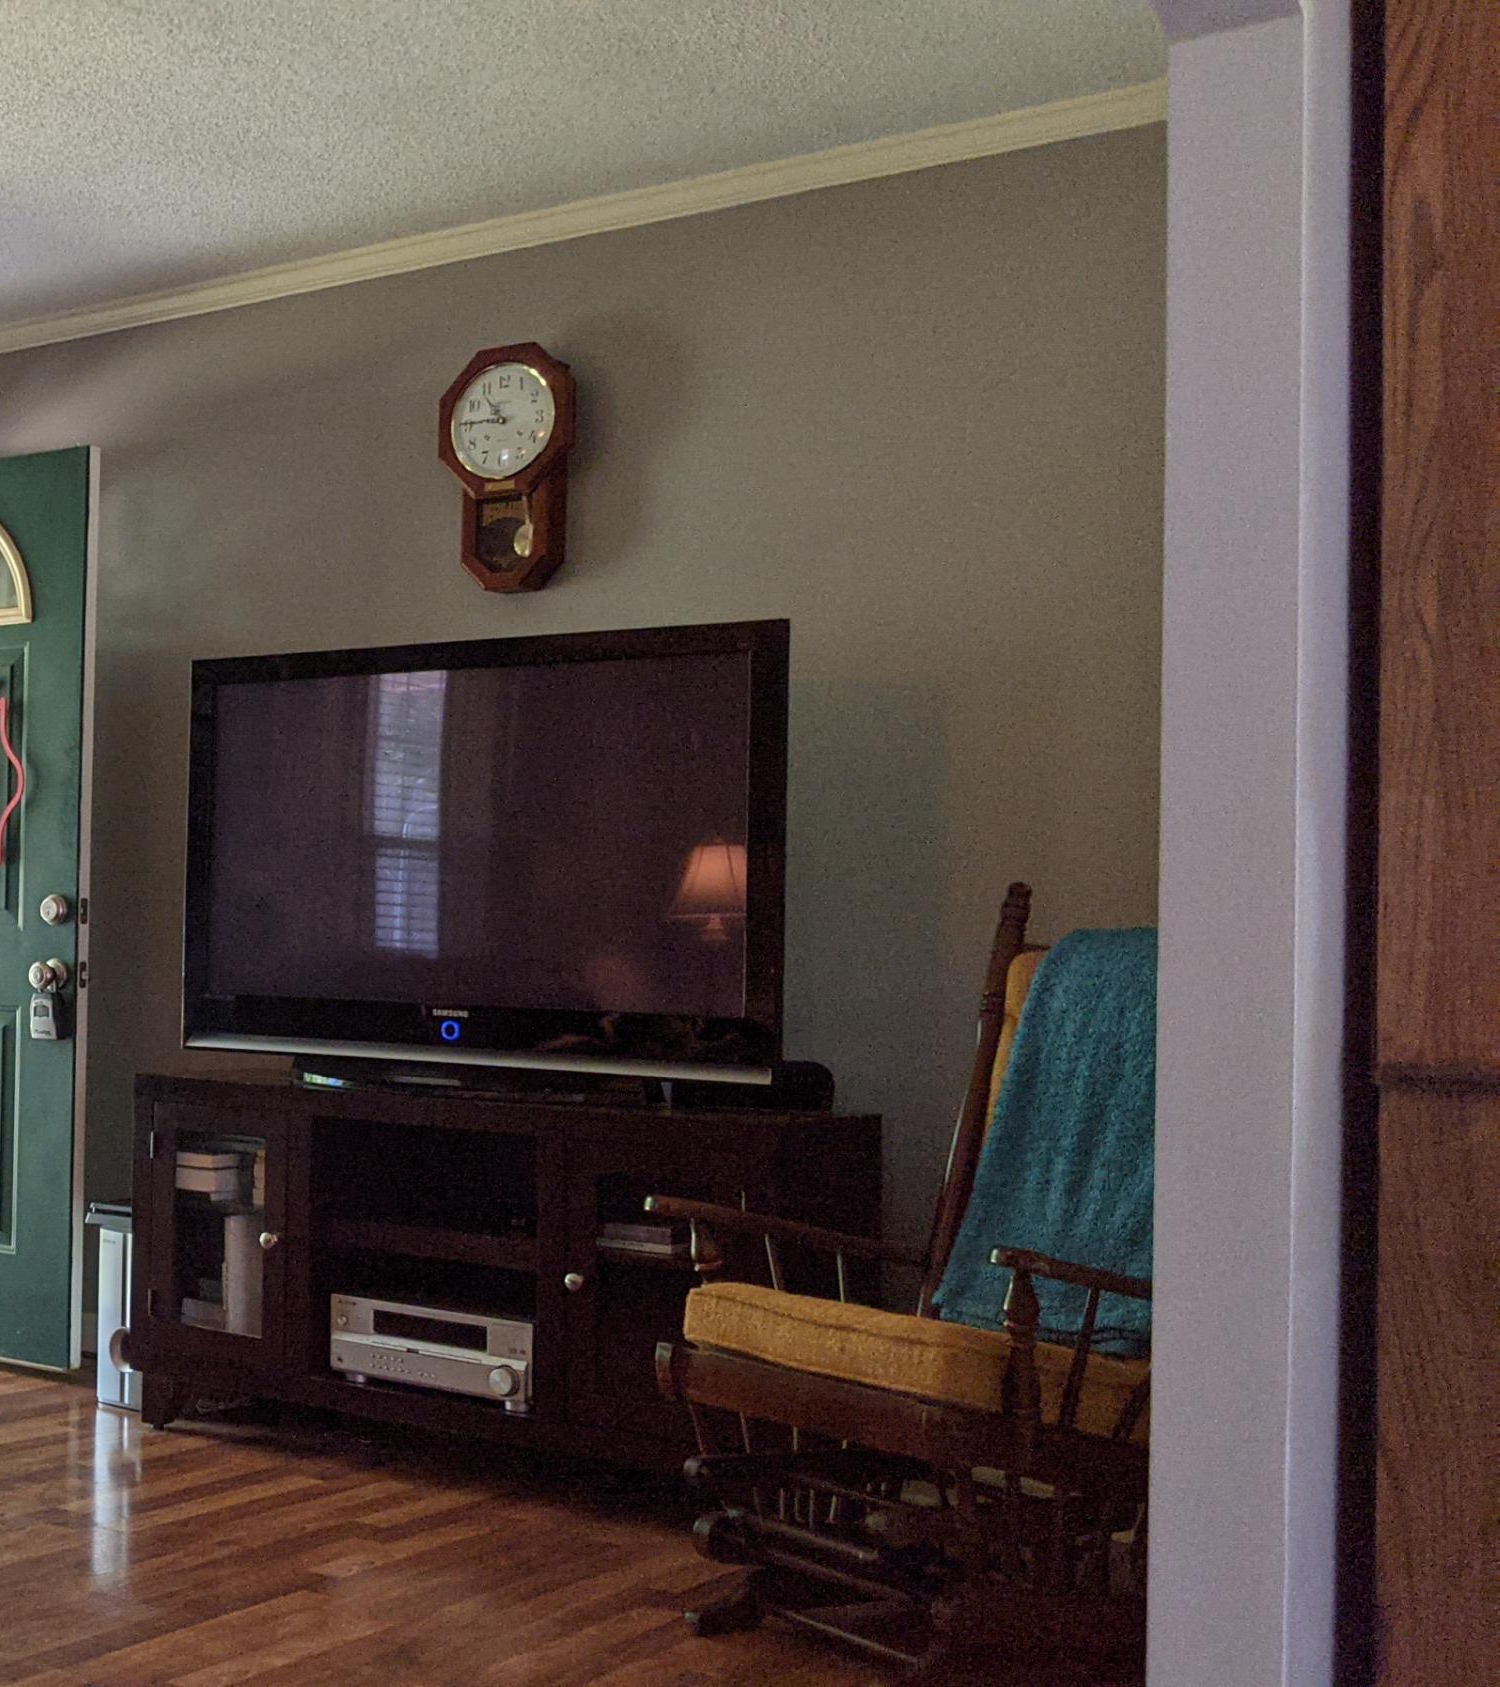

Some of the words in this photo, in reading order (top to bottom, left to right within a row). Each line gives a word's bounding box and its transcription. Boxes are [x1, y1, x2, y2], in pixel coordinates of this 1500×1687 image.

[482, 382, 492, 396] 11
[499, 375, 511, 389] 12
[530, 389, 540, 404] 2
[469, 399, 481, 413] 10
[534, 409, 544, 424] 3
[528, 430, 537, 444] 4
[467, 438, 477, 451] 8
[481, 450, 490, 465] 7
[432, 1008, 469, 1018] SAMSUNG
